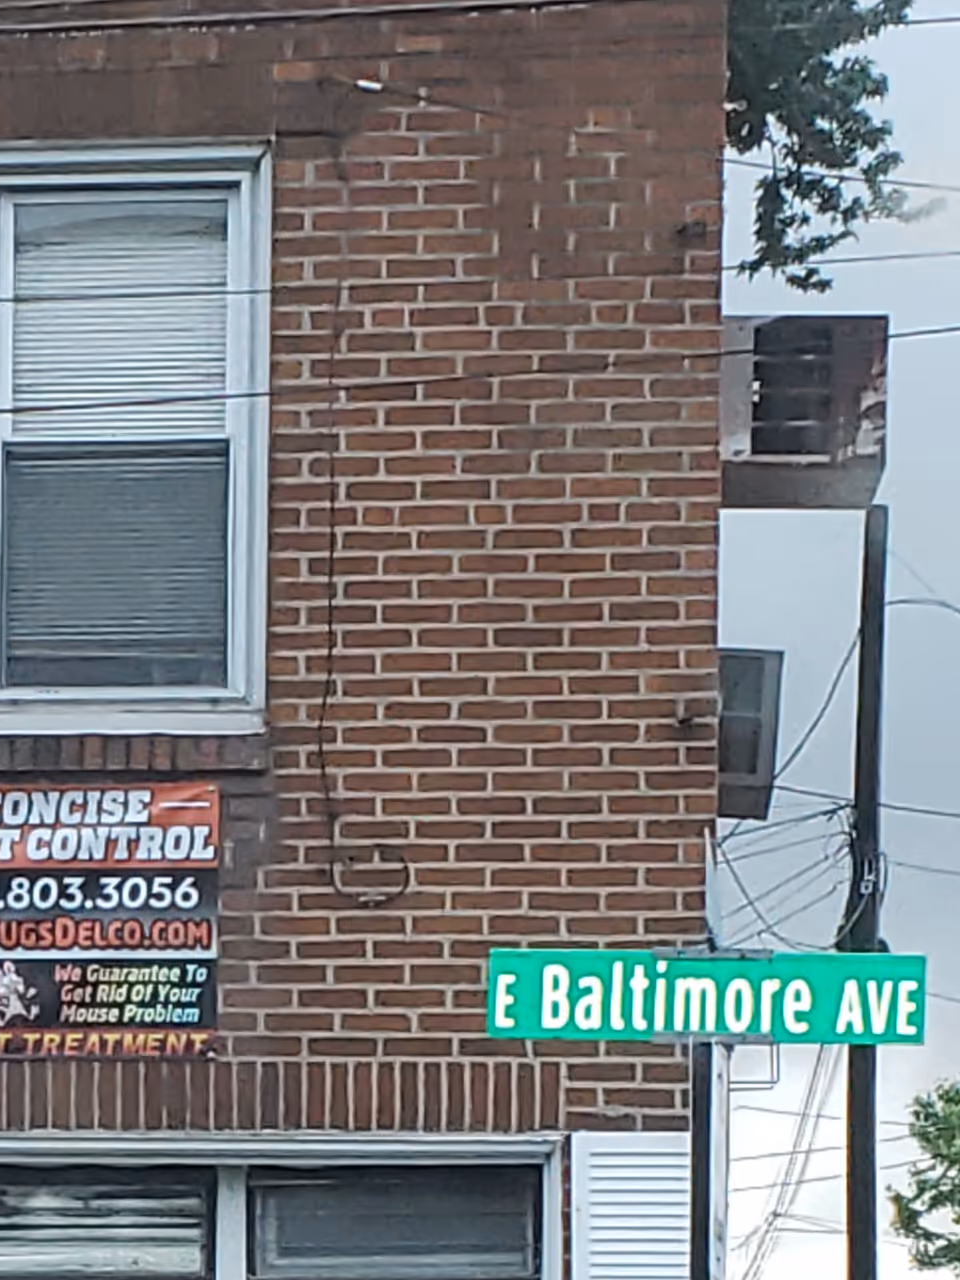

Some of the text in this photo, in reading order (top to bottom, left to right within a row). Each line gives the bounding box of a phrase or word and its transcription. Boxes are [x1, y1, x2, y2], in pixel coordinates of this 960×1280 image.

[26, 825, 216, 862] CONTROL
[54, 963, 208, 983] We Guarantee To
[60, 984, 202, 1004] Get Rid Of Your
[494, 960, 919, 1036] E Baltimore AVE
[59, 1004, 200, 1024] Mouse Problem
[22, 1031, 209, 1057] TREATMENT
